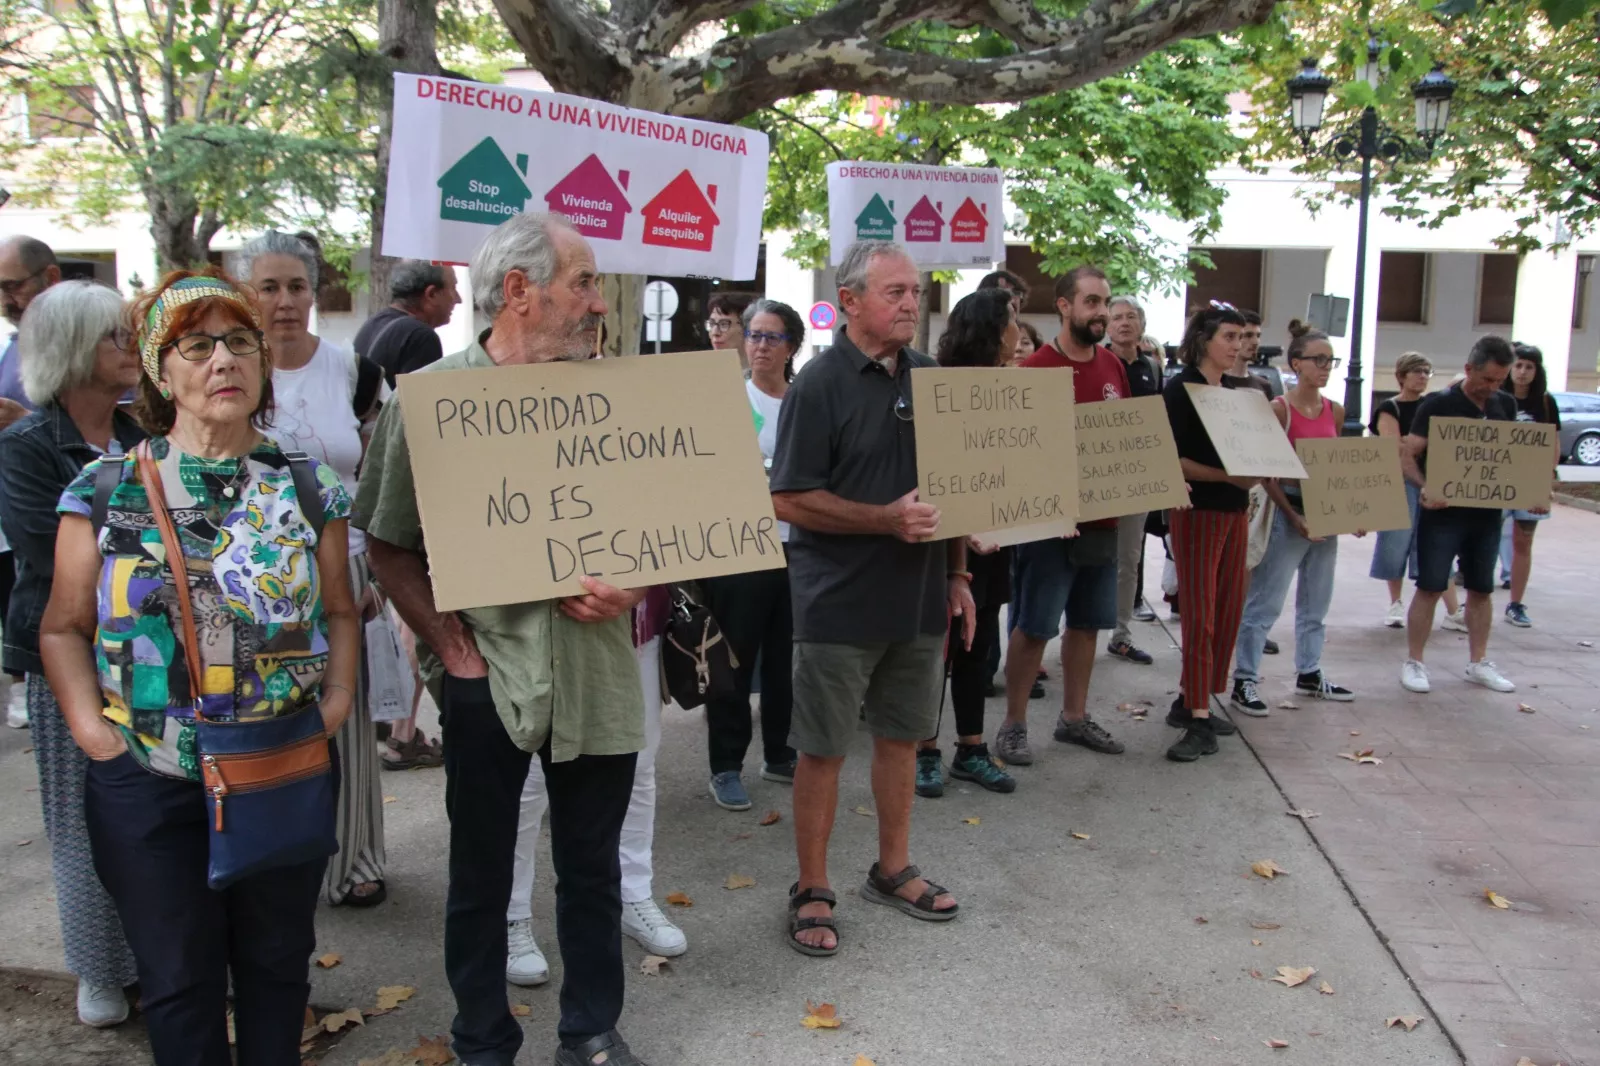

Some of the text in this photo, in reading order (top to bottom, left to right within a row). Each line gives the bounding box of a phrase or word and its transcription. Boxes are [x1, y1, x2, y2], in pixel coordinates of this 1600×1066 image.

[417, 77, 748, 157] DERECHO A UNA VIVIENDA DIGNA
[839, 166, 999, 185] DERECHO A UNA VIVIENDA DIGNA
[468, 179, 500, 198] Stop
[445, 195, 520, 216] desahucios
[561, 193, 614, 212] Vivienda
[658, 207, 702, 226] Alquiler
[651, 224, 705, 242] asequible
[933, 379, 1034, 414] EL BUITRE
[435, 386, 612, 439] PRIORIDAD
[962, 420, 1043, 452] INVERSOR
[1092, 439, 1116, 454] LAS
[1119, 434, 1162, 452] NUBES
[1437, 424, 1551, 448] VIVIENDA SOCIAL
[556, 425, 716, 470] NACIONAL
[1301, 447, 1319, 467] LA
[1326, 447, 1383, 465] VIVIENDA
[1454, 445, 1513, 465] PUBLICA
[1082, 460, 1147, 480] SALARIOS
[1463, 465, 1498, 481] Y DE
[927, 465, 1006, 497] ES EL GRAN
[1102, 488, 1121, 501] LOS
[1127, 480, 1169, 498] SUELOS
[1327, 473, 1392, 491] NOS CUESTA
[1442, 480, 1517, 502] CALIDAD
[486, 476, 594, 527] NO ES
[991, 493, 1064, 527] INVASOR
[1319, 496, 1370, 517] LA VIDA
[545, 515, 779, 583] DESAHUCIAR
